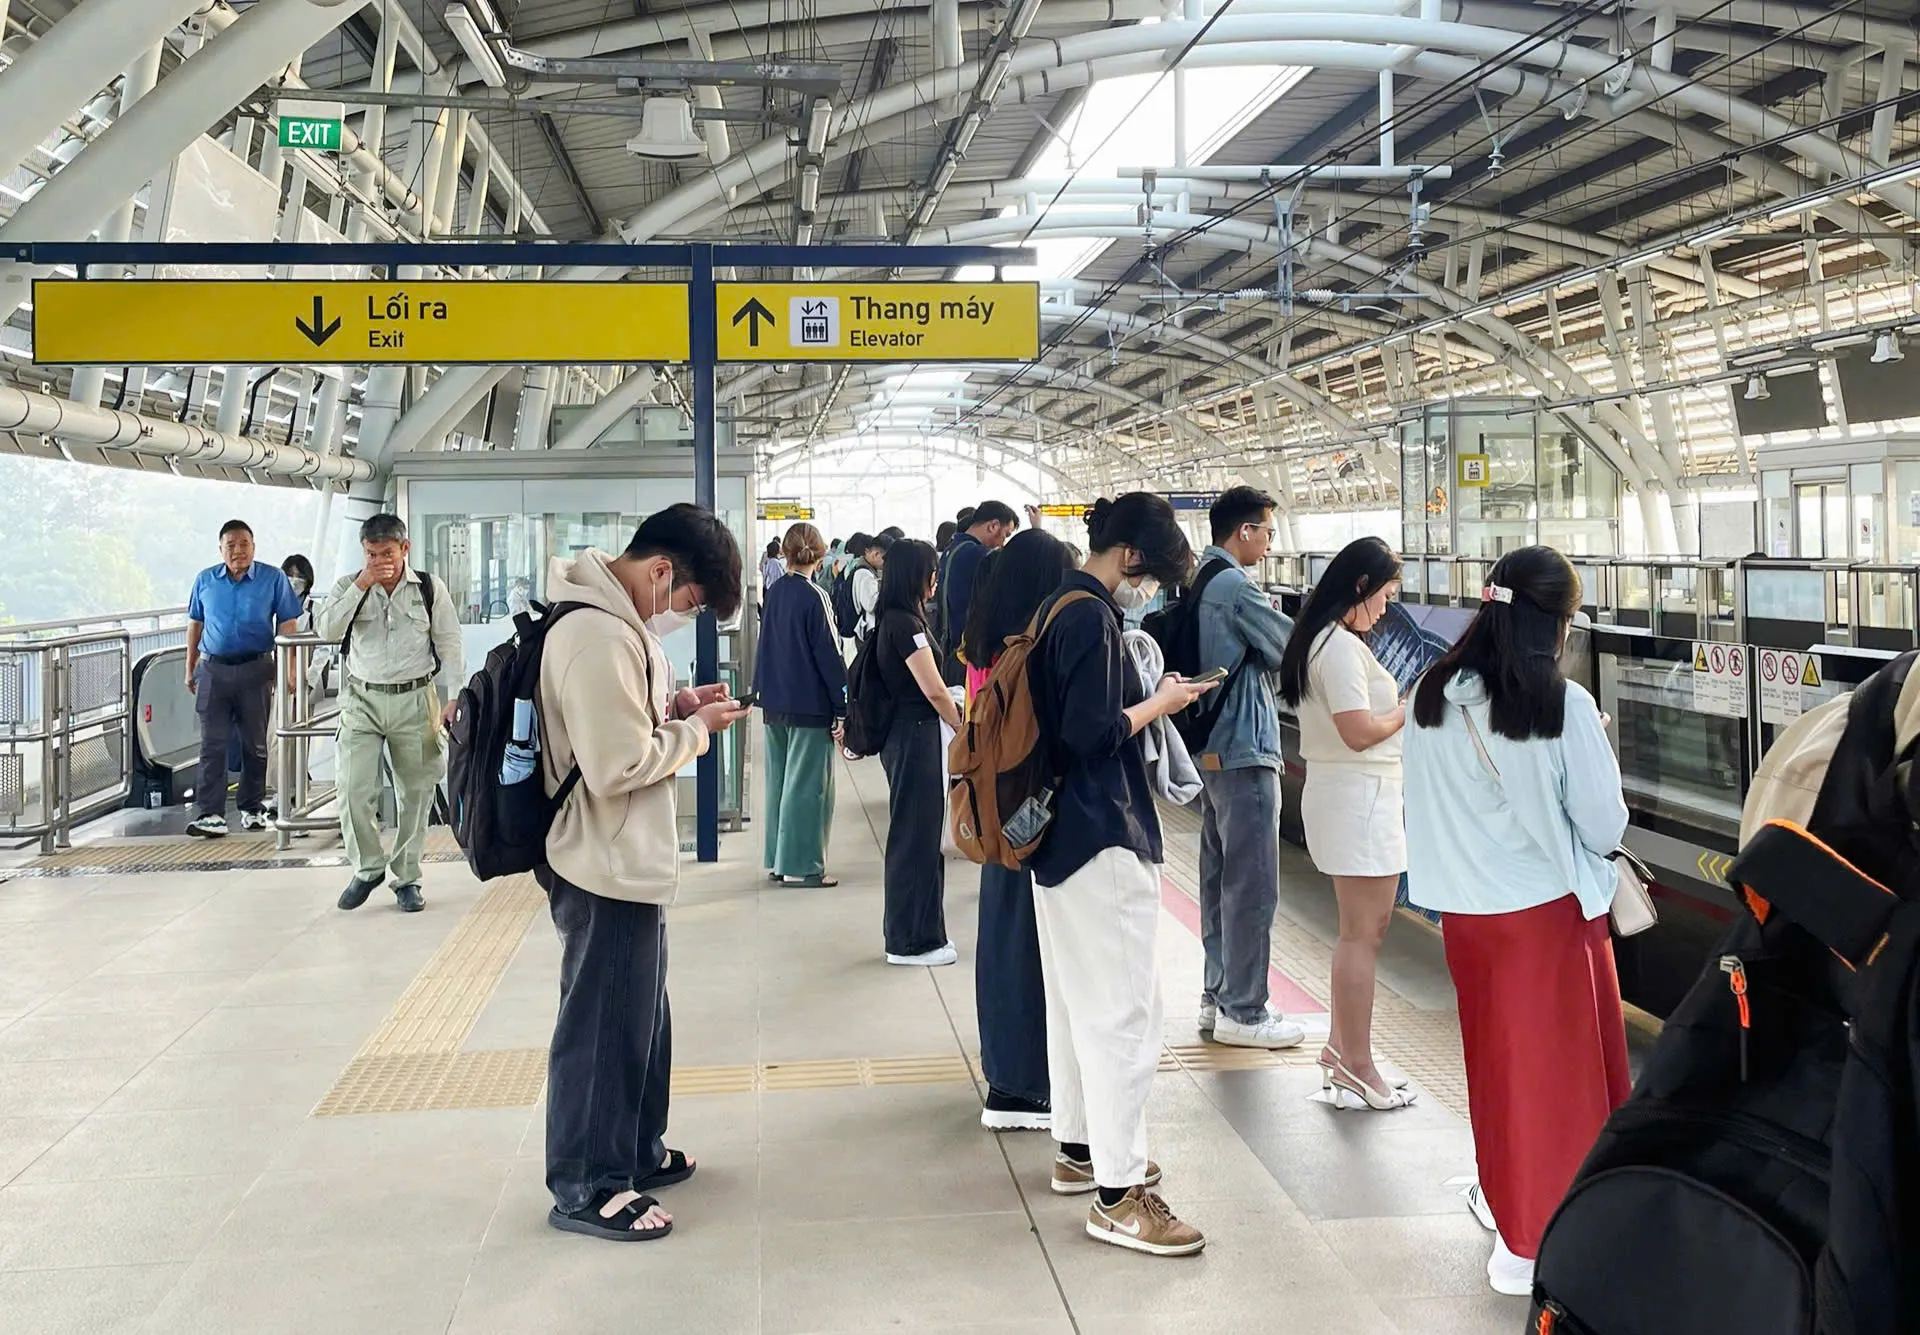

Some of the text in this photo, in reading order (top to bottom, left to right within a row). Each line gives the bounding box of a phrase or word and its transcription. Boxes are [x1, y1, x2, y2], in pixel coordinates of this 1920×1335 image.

[288, 122, 332, 144] EXIT
[368, 292, 447, 320] Lối ra
[849, 296, 994, 325] Thang máy
[368, 331, 404, 347] Exit
[850, 330, 925, 347] Elevator
